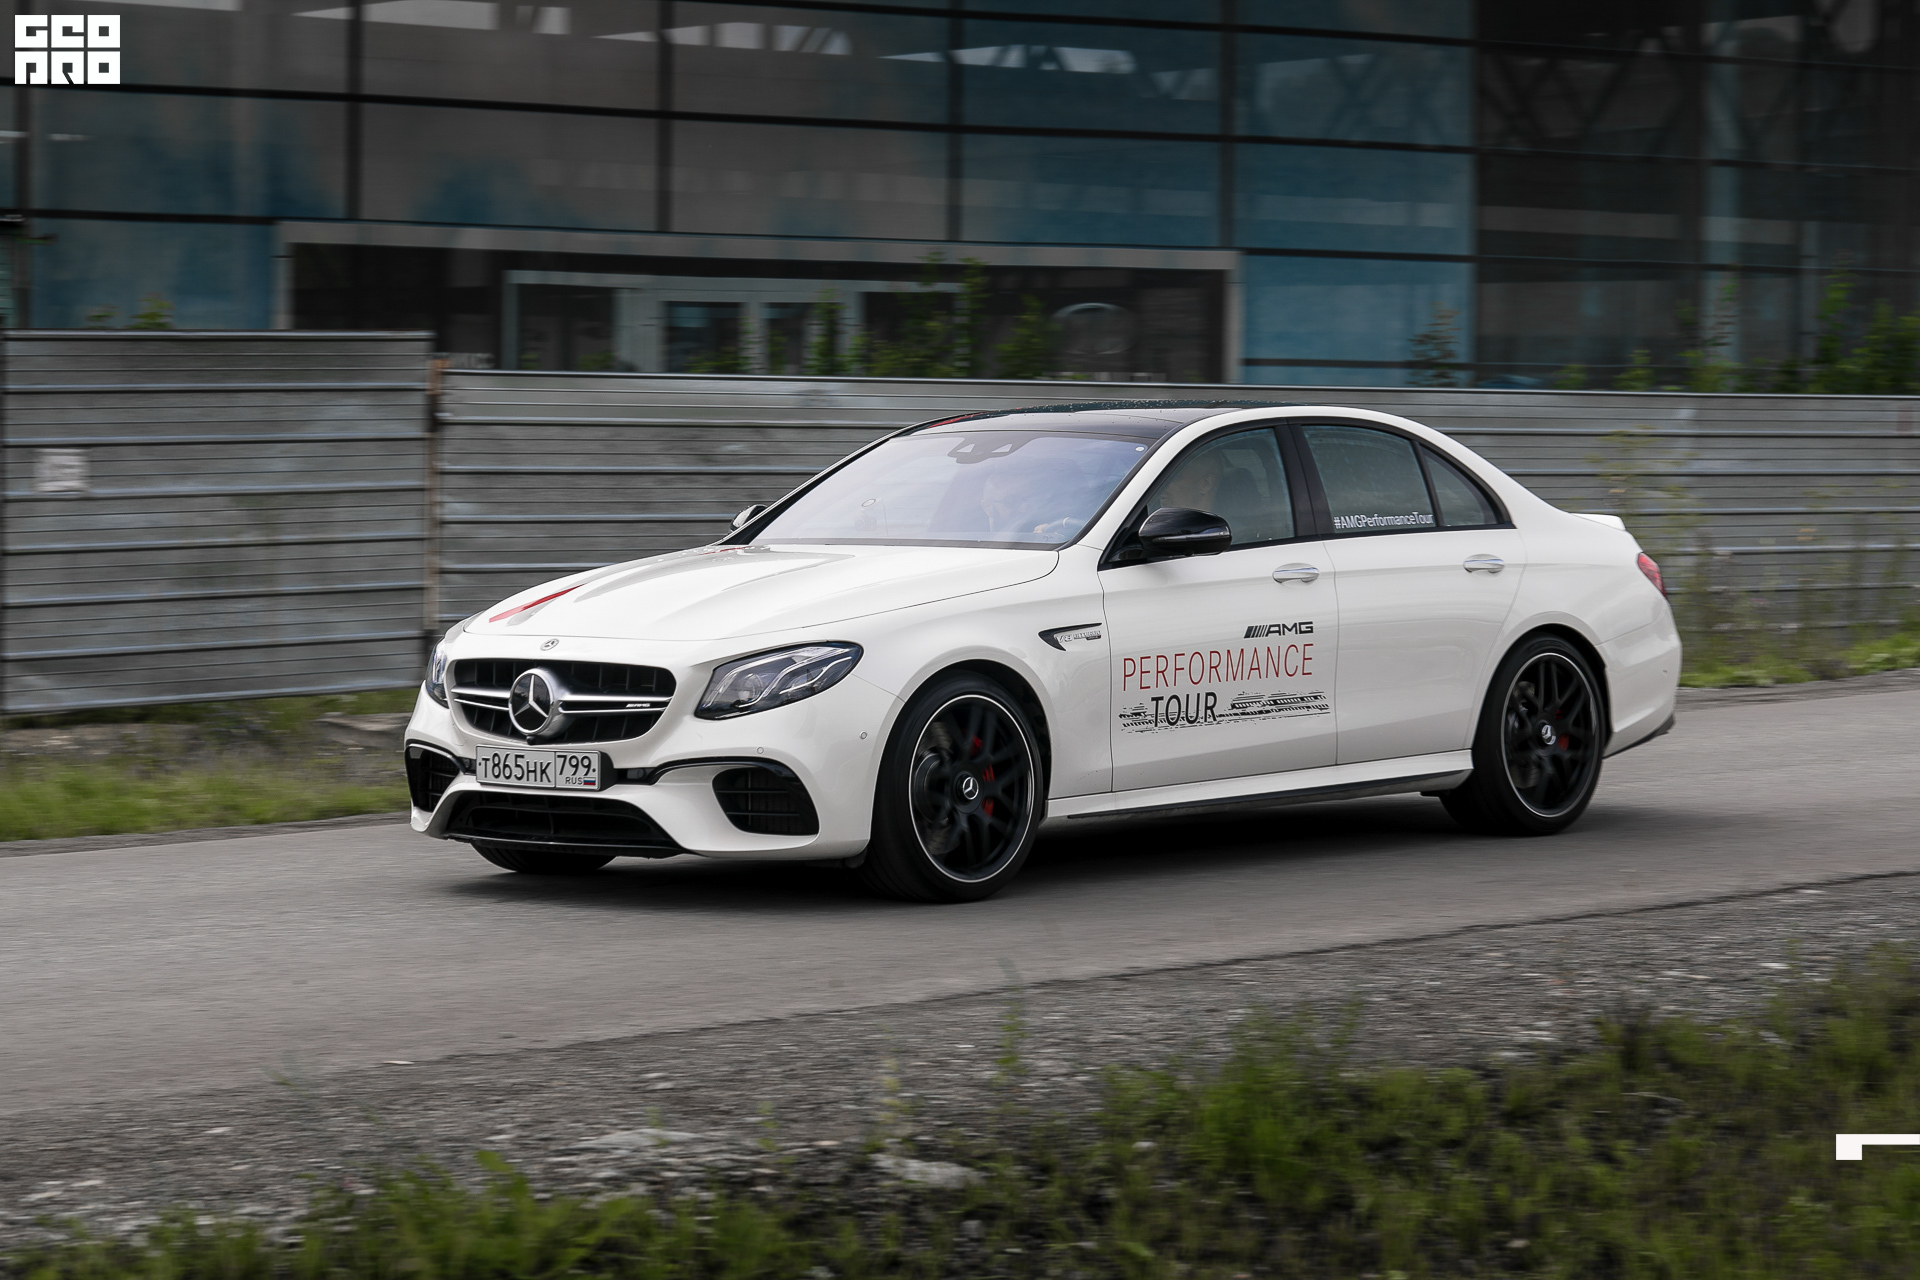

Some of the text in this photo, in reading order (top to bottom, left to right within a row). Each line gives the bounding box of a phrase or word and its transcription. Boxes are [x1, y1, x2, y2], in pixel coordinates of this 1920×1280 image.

[1333, 511, 1434, 529] #AMGPerformanceTour
[1262, 621, 1314, 637] AMG
[1122, 643, 1314, 692] PERFORMANCE
[1151, 691, 1218, 727] TOUR
[556, 754, 592, 776] 799
[565, 776, 583, 785] RUS
